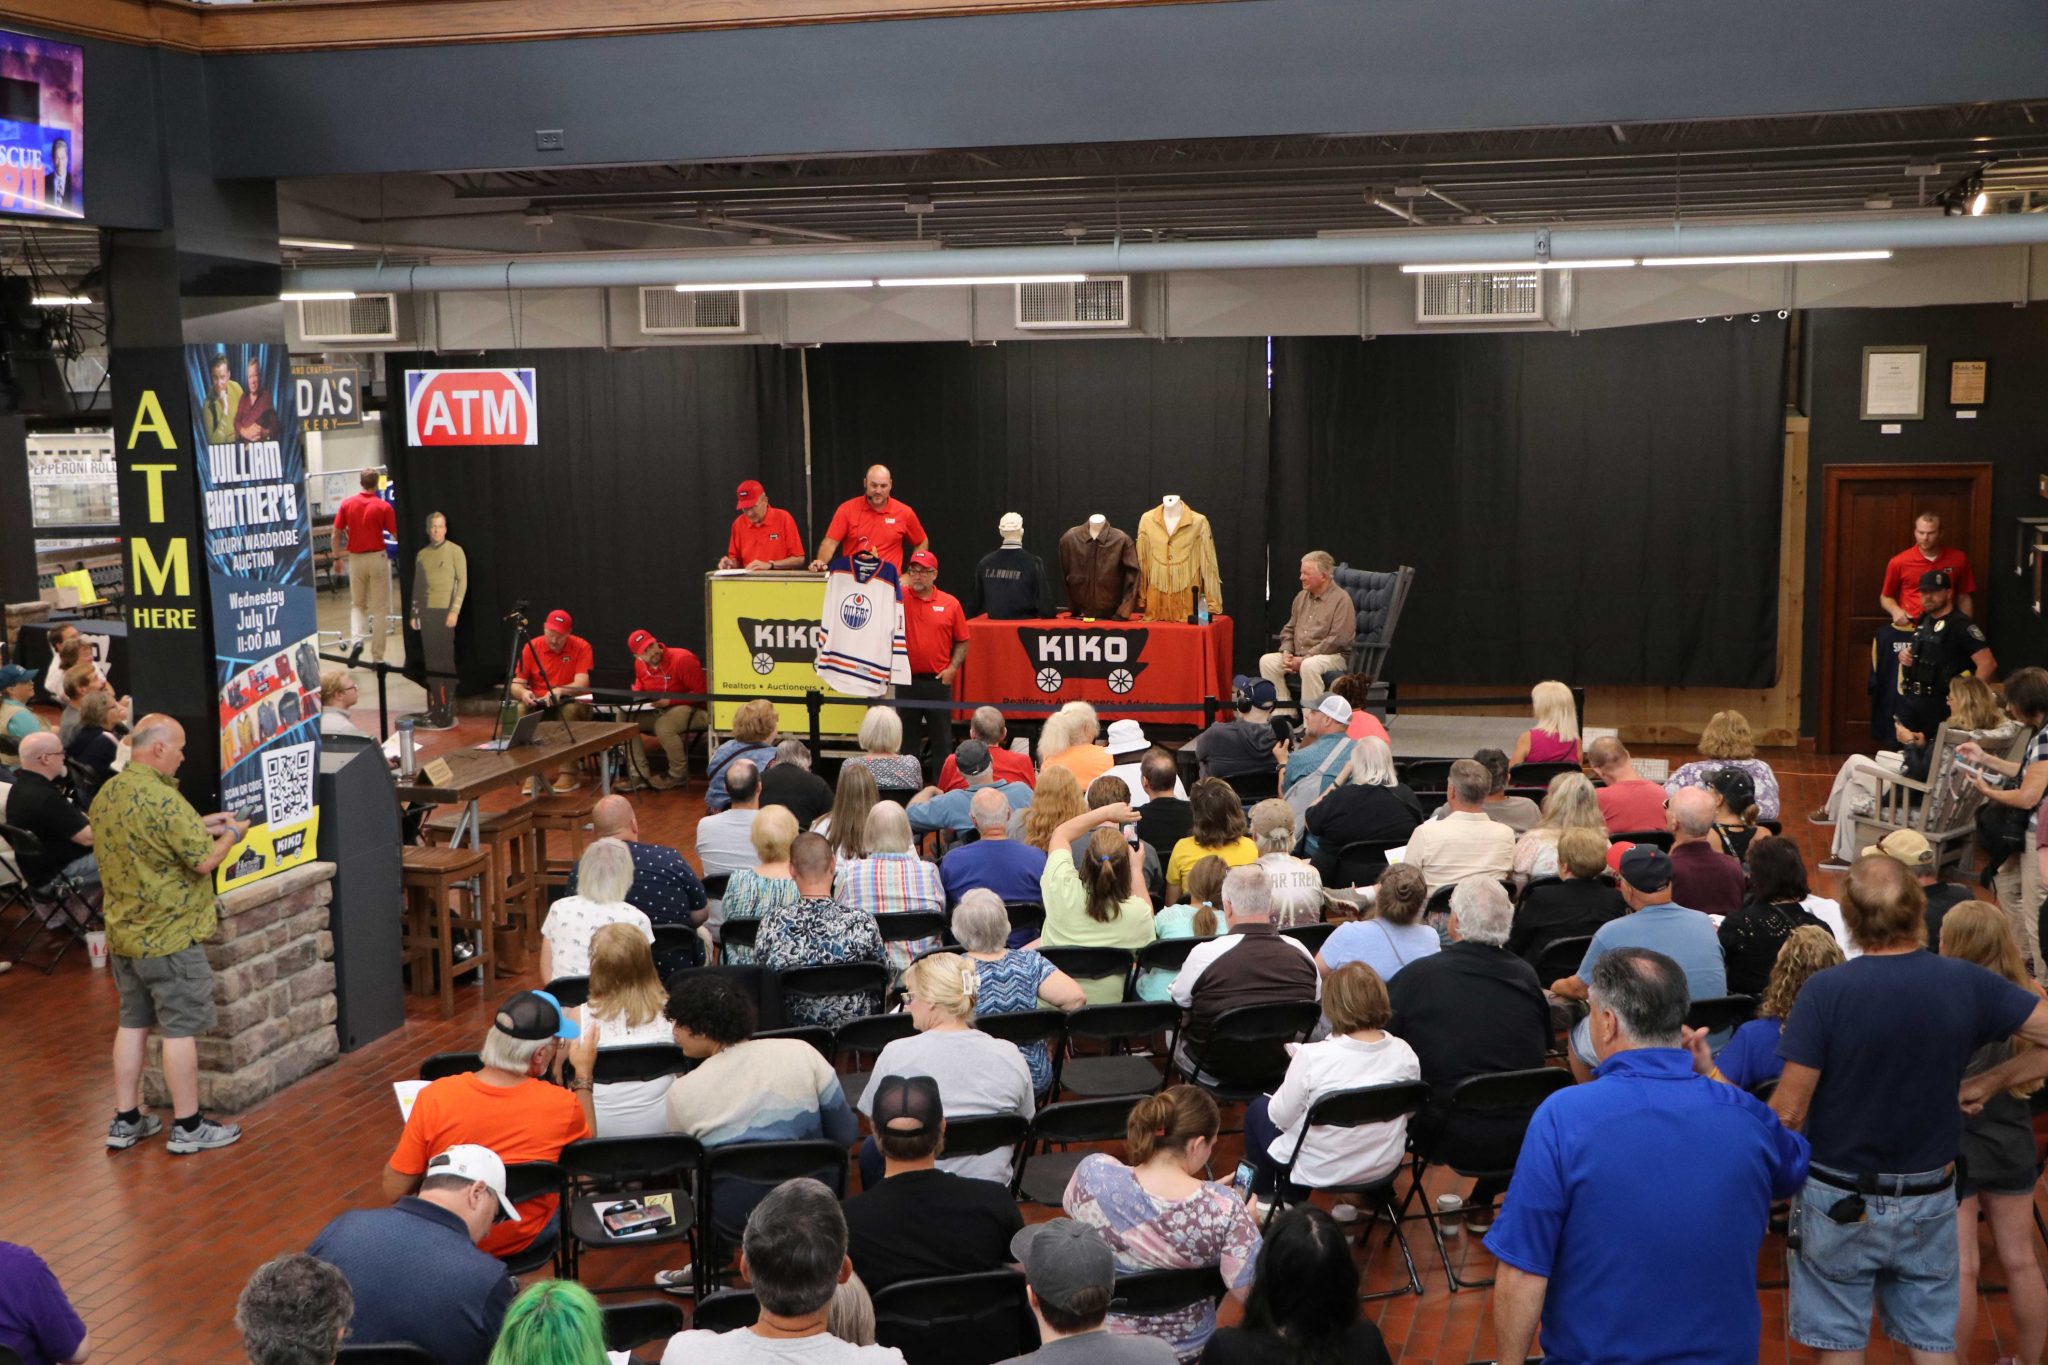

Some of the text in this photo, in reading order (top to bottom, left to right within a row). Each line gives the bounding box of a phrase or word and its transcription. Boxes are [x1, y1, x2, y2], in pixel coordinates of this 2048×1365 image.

[303, 418, 338, 431] KERY
[423, 389, 518, 436] ATM
[208, 441, 283, 484] WILLIAM
[205, 483, 298, 530] SHATNER'S
[211, 529, 299, 556] LUXURY WARDROBE
[233, 550, 275, 571] AUCTION
[229, 587, 285, 610] Wednesday
[133, 608, 196, 629] HERE
[237, 605, 278, 633] July 17
[843, 604, 869, 628] OILERS
[237, 629, 281, 653] 11:00 AM
[1038, 635, 1128, 662] KIKO
[722, 681, 756, 690] Realtors
[767, 682, 817, 692] Auctioneers
[276, 832, 302, 854] KIKO
